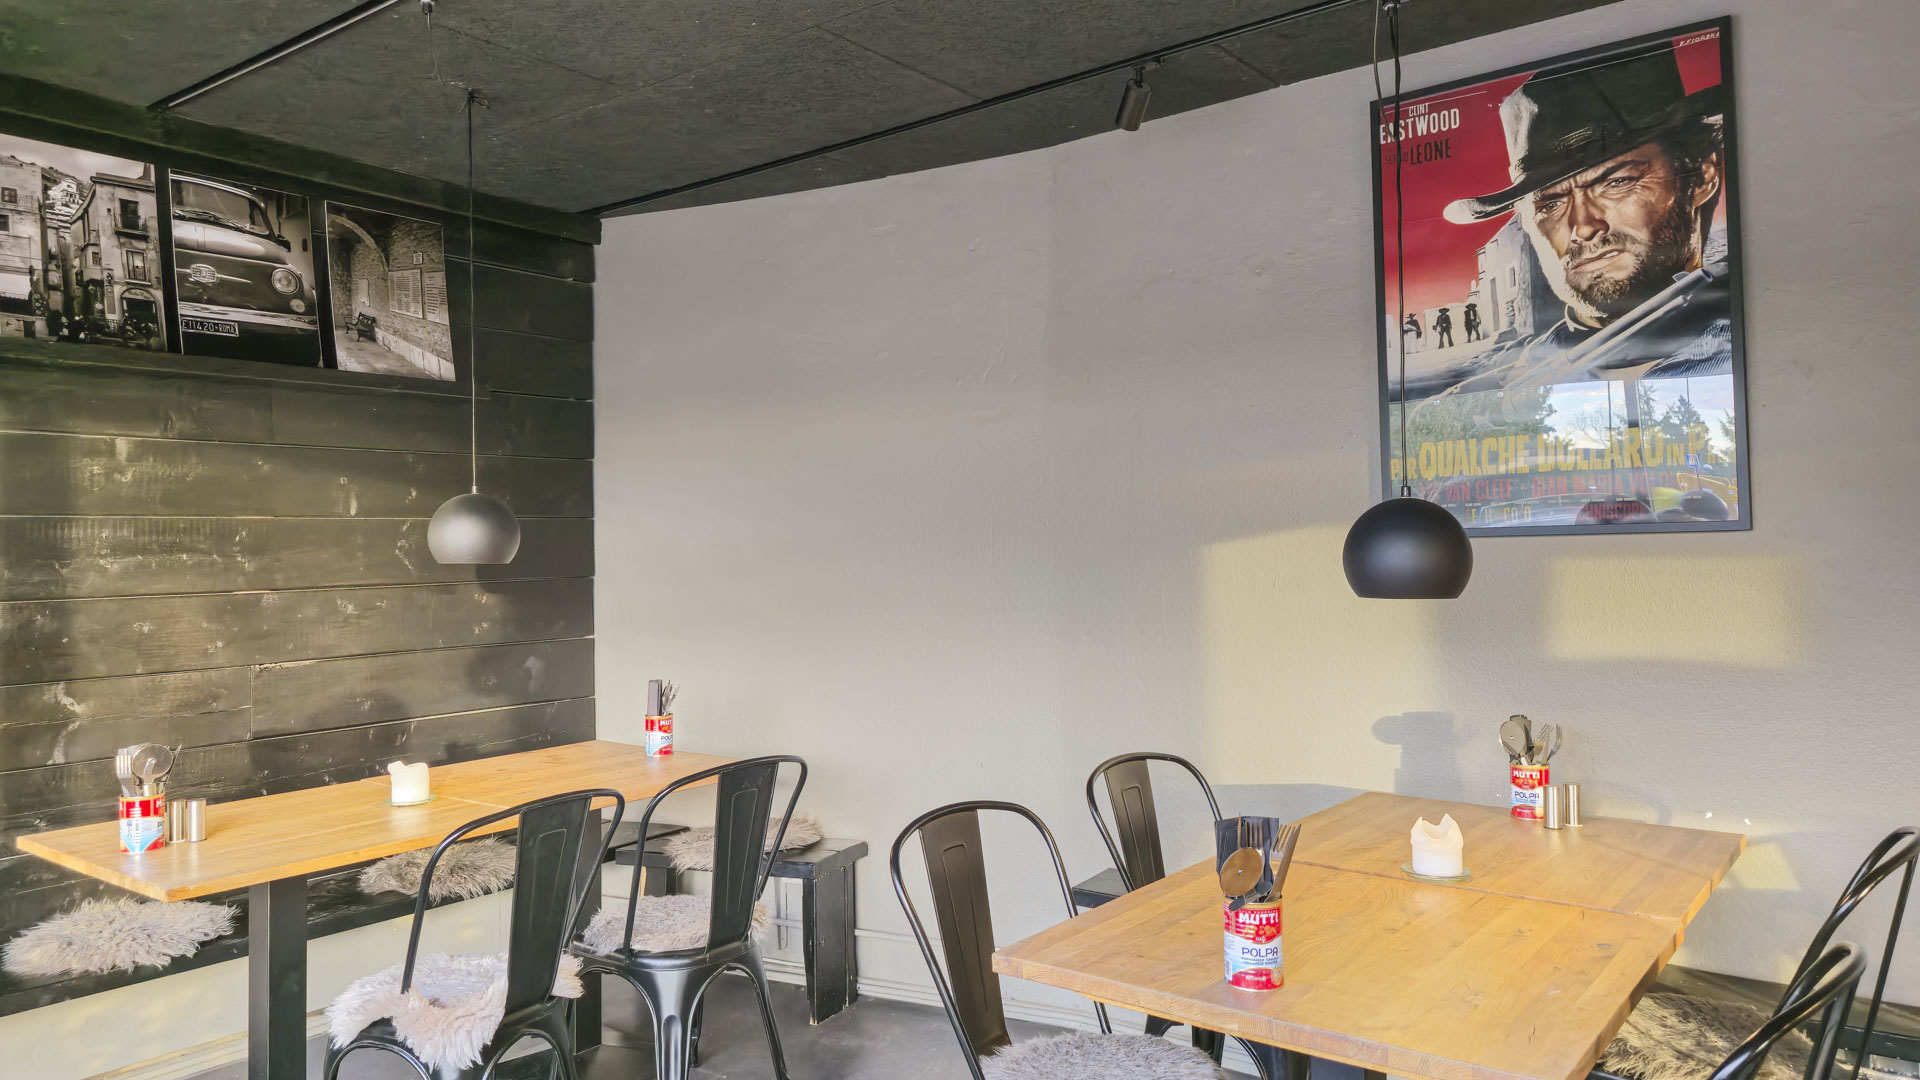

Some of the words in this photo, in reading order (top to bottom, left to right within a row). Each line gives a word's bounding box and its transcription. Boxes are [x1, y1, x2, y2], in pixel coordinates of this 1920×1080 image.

[1408, 103, 1429, 117] CLINT
[1380, 108, 1460, 145] EASTWOOD
[1410, 138, 1452, 165] LEONE
[1418, 435, 1530, 481] QUALCHE
[1537, 427, 1664, 473] DOLLARO
[1666, 443, 1685, 467] IN
[1446, 480, 1471, 502] VAN
[1475, 478, 1513, 502] CLEEF
[1532, 475, 1568, 498] GIAN
[1513, 770, 1540, 779] MUTTI
[1514, 791, 1540, 800] POLPA
[1238, 912, 1279, 925] MUTTI
[1241, 946, 1279, 958] POLPA
